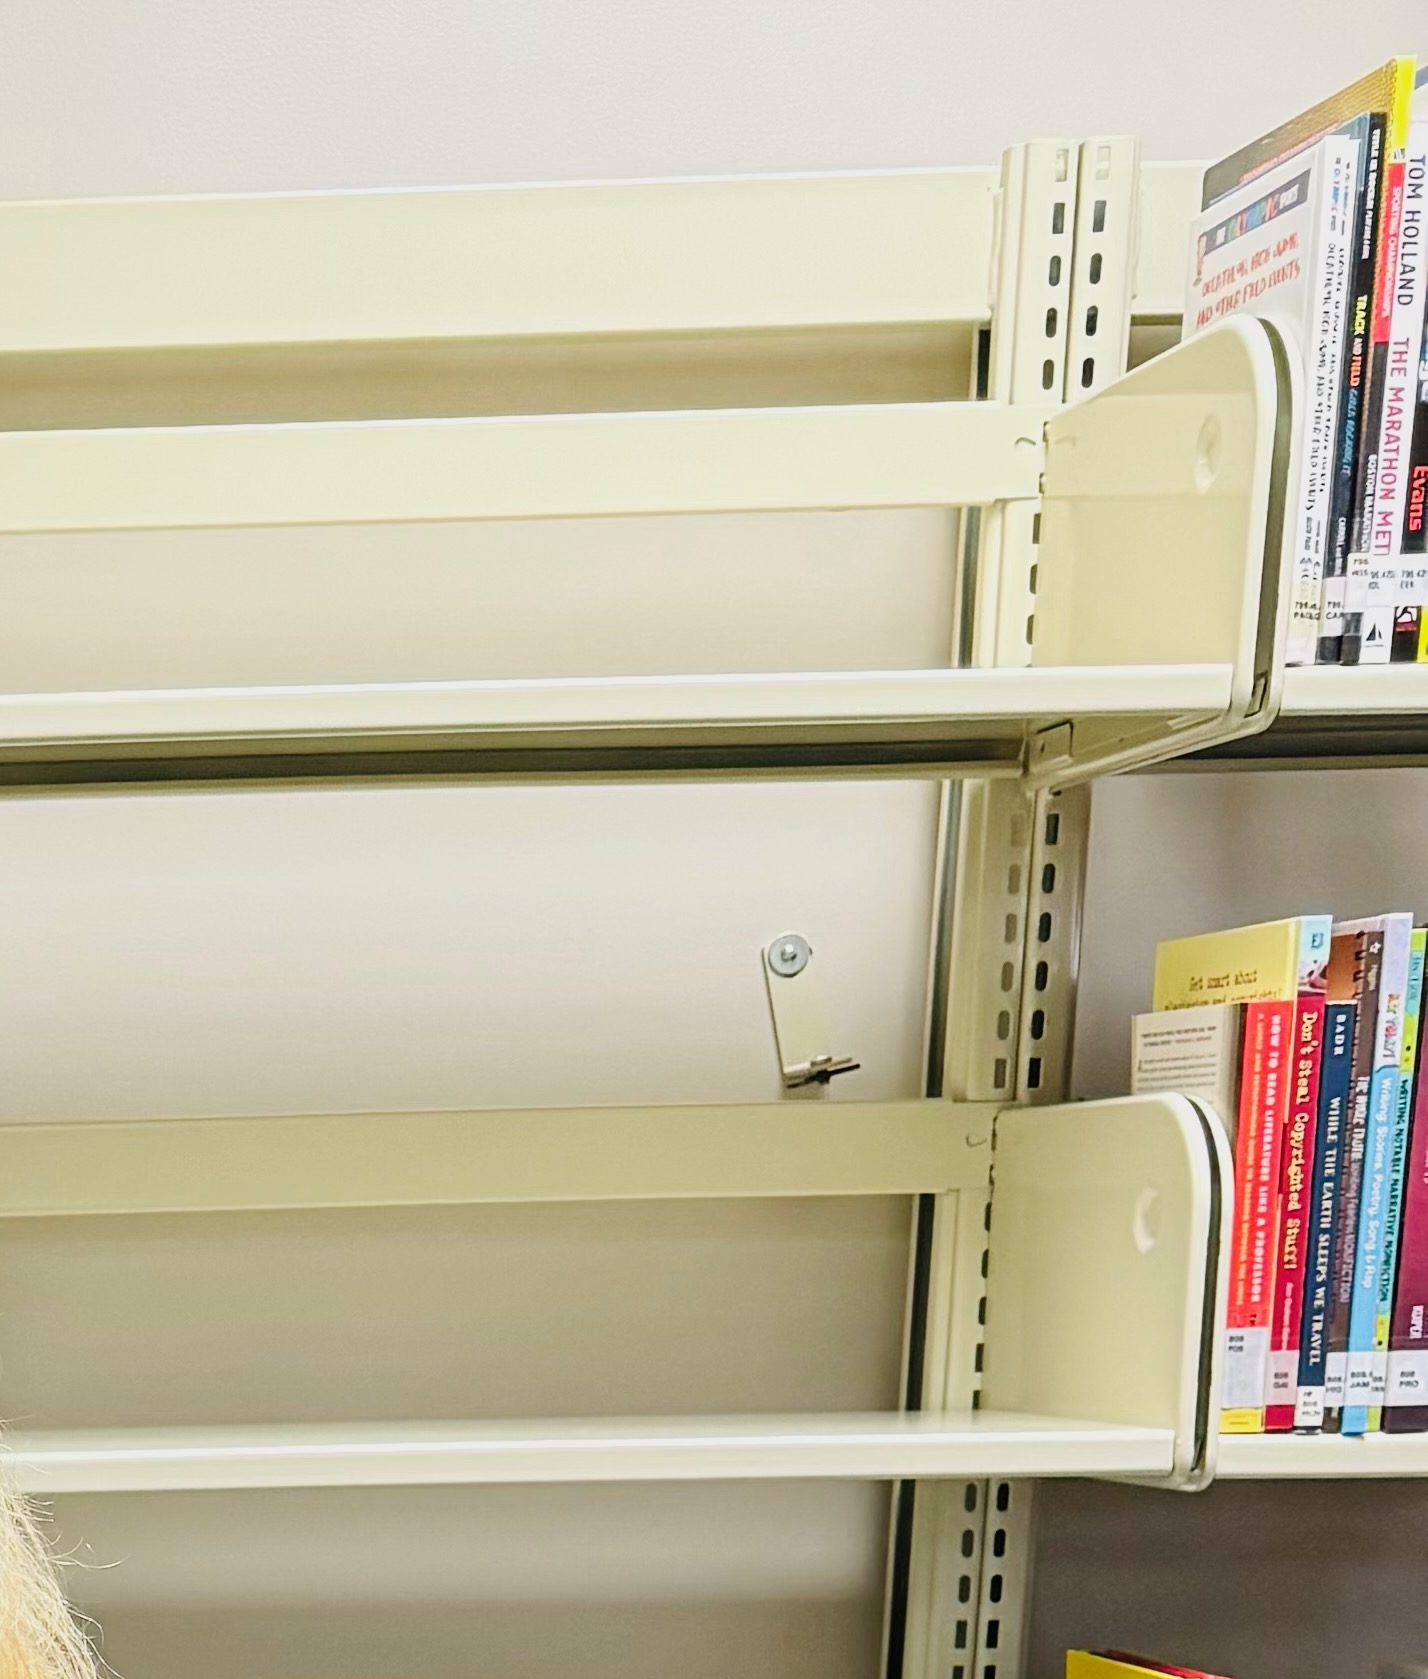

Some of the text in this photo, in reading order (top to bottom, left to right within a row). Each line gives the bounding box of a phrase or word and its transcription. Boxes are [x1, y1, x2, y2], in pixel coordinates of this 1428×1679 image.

[1349, 295, 1368, 386] TRACK FIELD
[1378, 155, 1426, 500] TOM HOLLAND THE MARATHON
[1408, 465, 1428, 532] Evans
[1251, 1015, 1281, 1302] HOW TO READ LITERATURE LIKE A PROFESSOR
[1283, 1012, 1319, 1269] Don't Steal Copyrighted Stuff!
[1308, 1015, 1346, 1366] BADR WHILE THE EARTH SLEEPS WE TRAVEL
[1375, 1079, 1392, 1121] Writing
[1384, 1080, 1408, 1236] WRITING NOTABLE NARRATIVE
